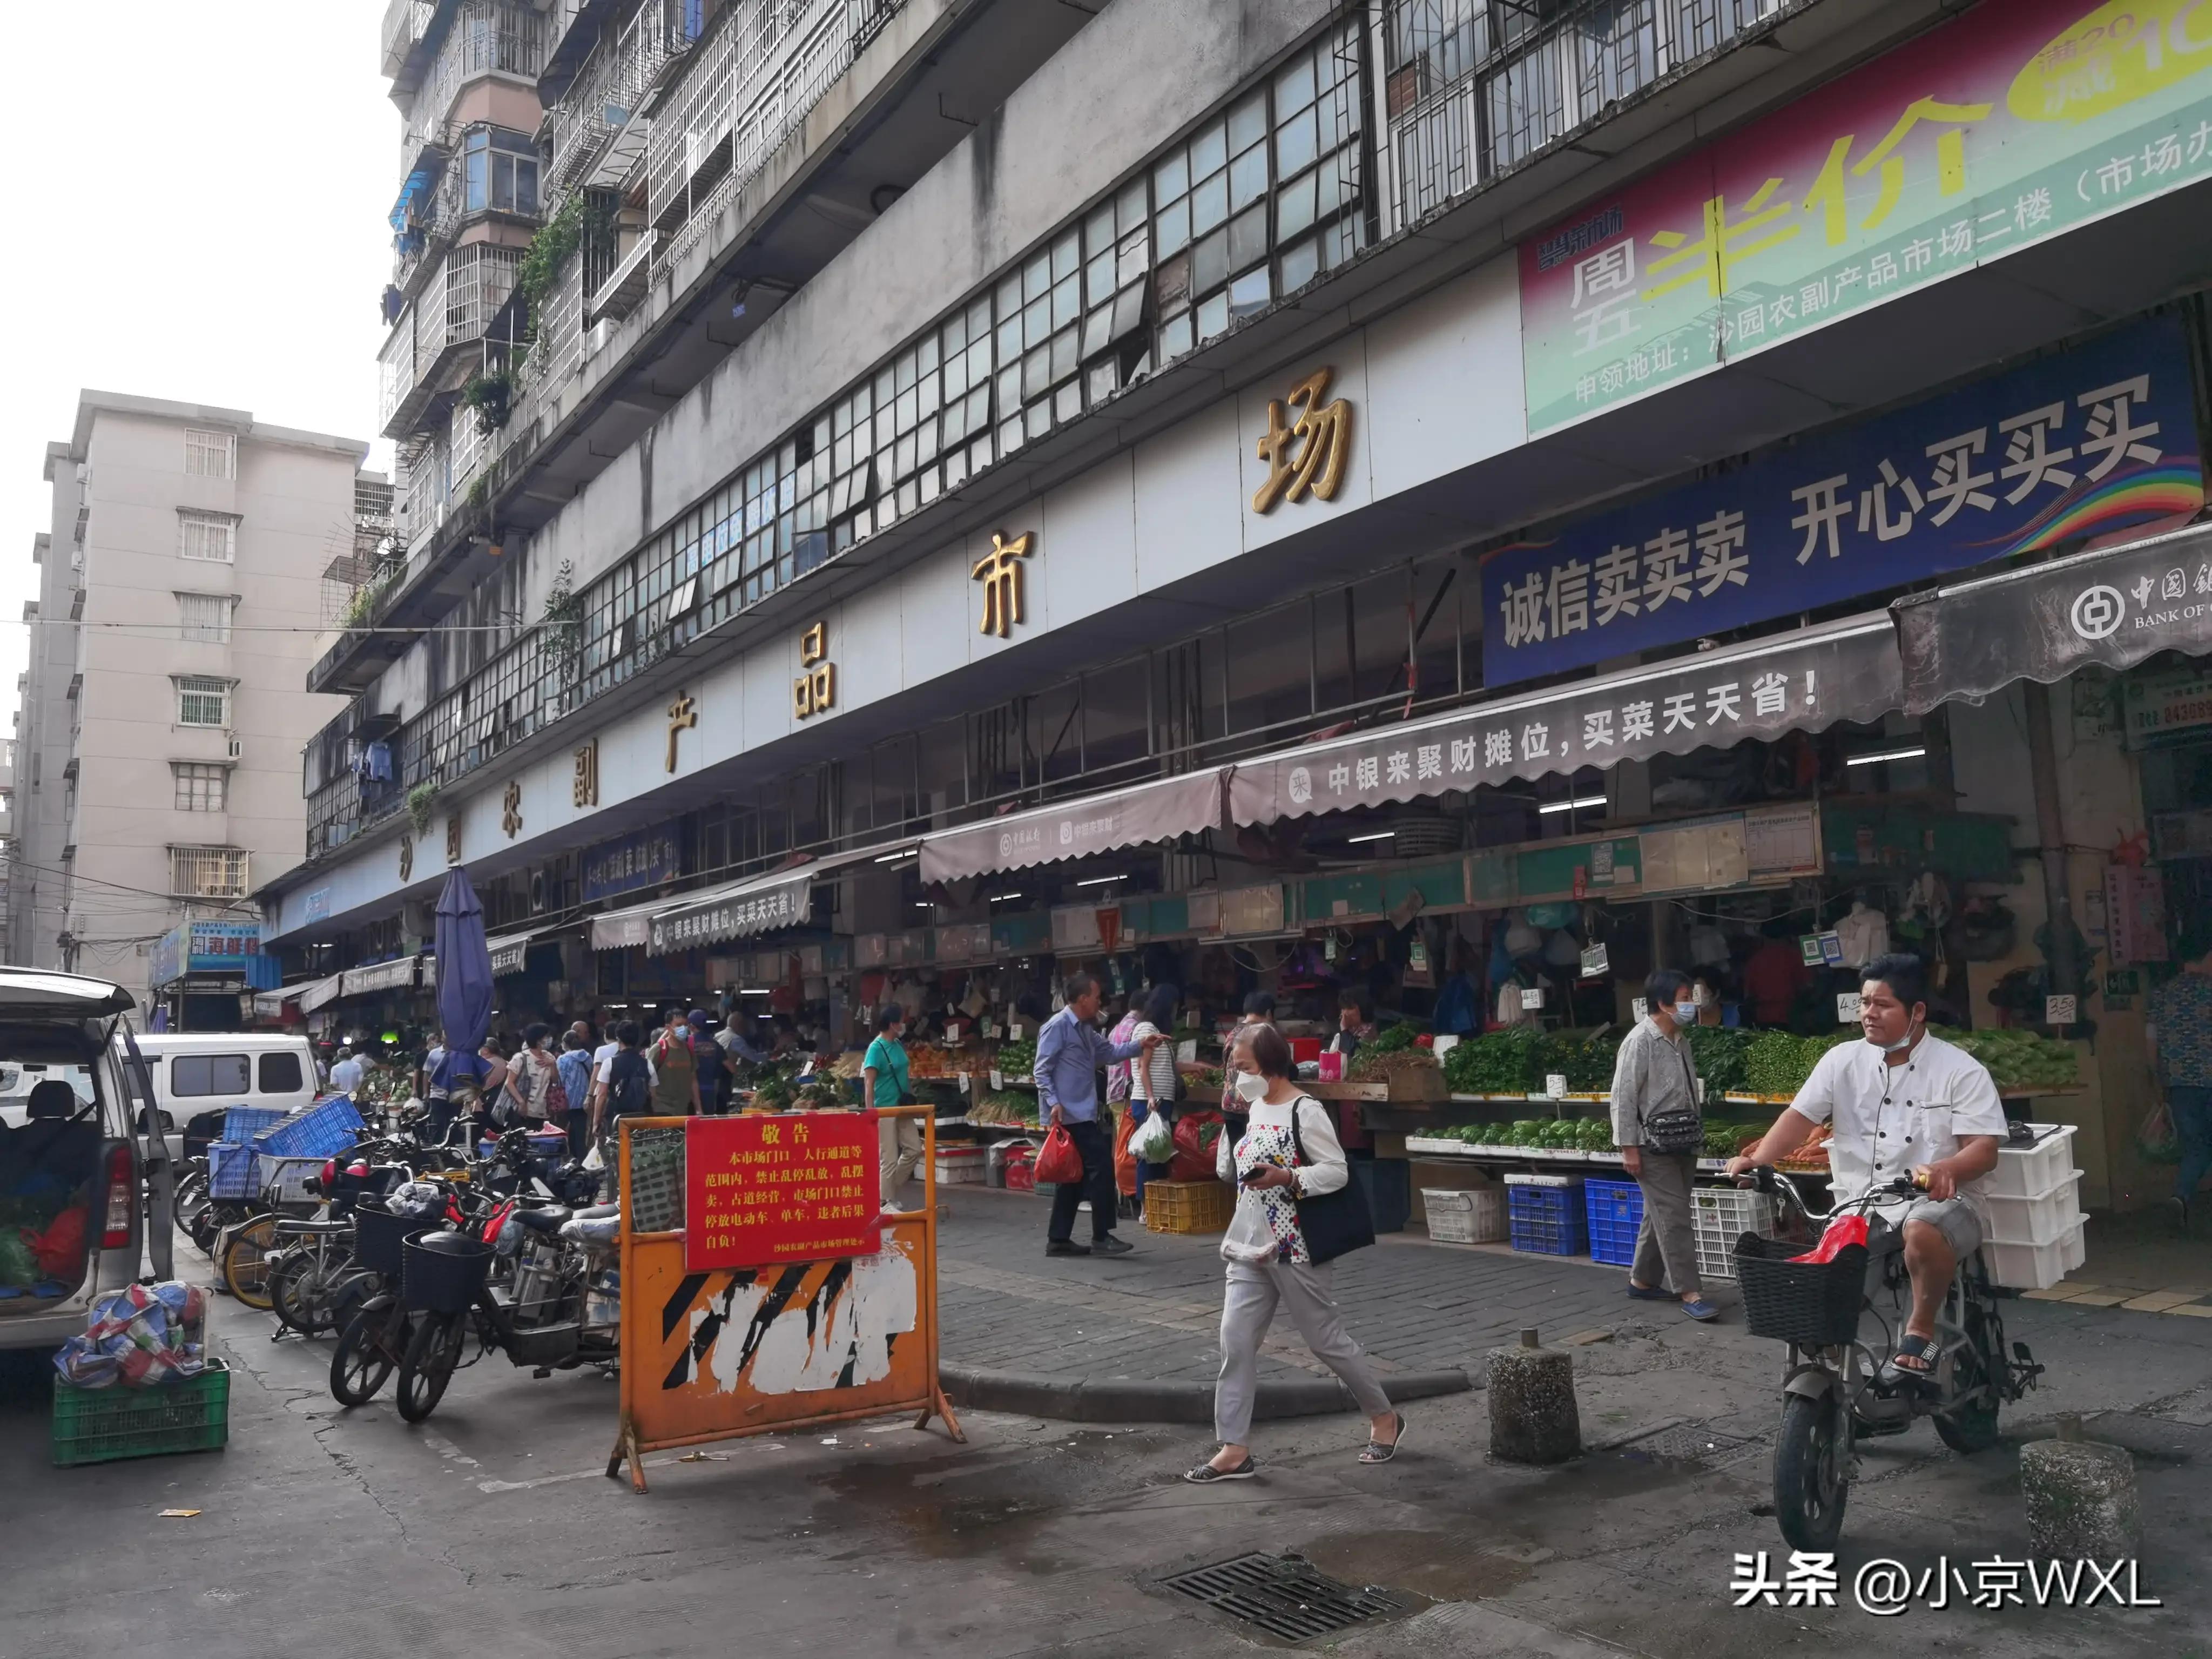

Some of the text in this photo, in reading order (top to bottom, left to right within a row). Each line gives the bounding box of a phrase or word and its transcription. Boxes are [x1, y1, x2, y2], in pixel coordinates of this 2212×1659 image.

[1640, 95, 1994, 300] 半价
[1570, 237, 1642, 358] 周五
[1501, 374, 2163, 649] 诚信卖卖卖 开心买买买
[2134, 604, 2205, 629] BANK OF
[761, 1123, 810, 1145] 敬告
